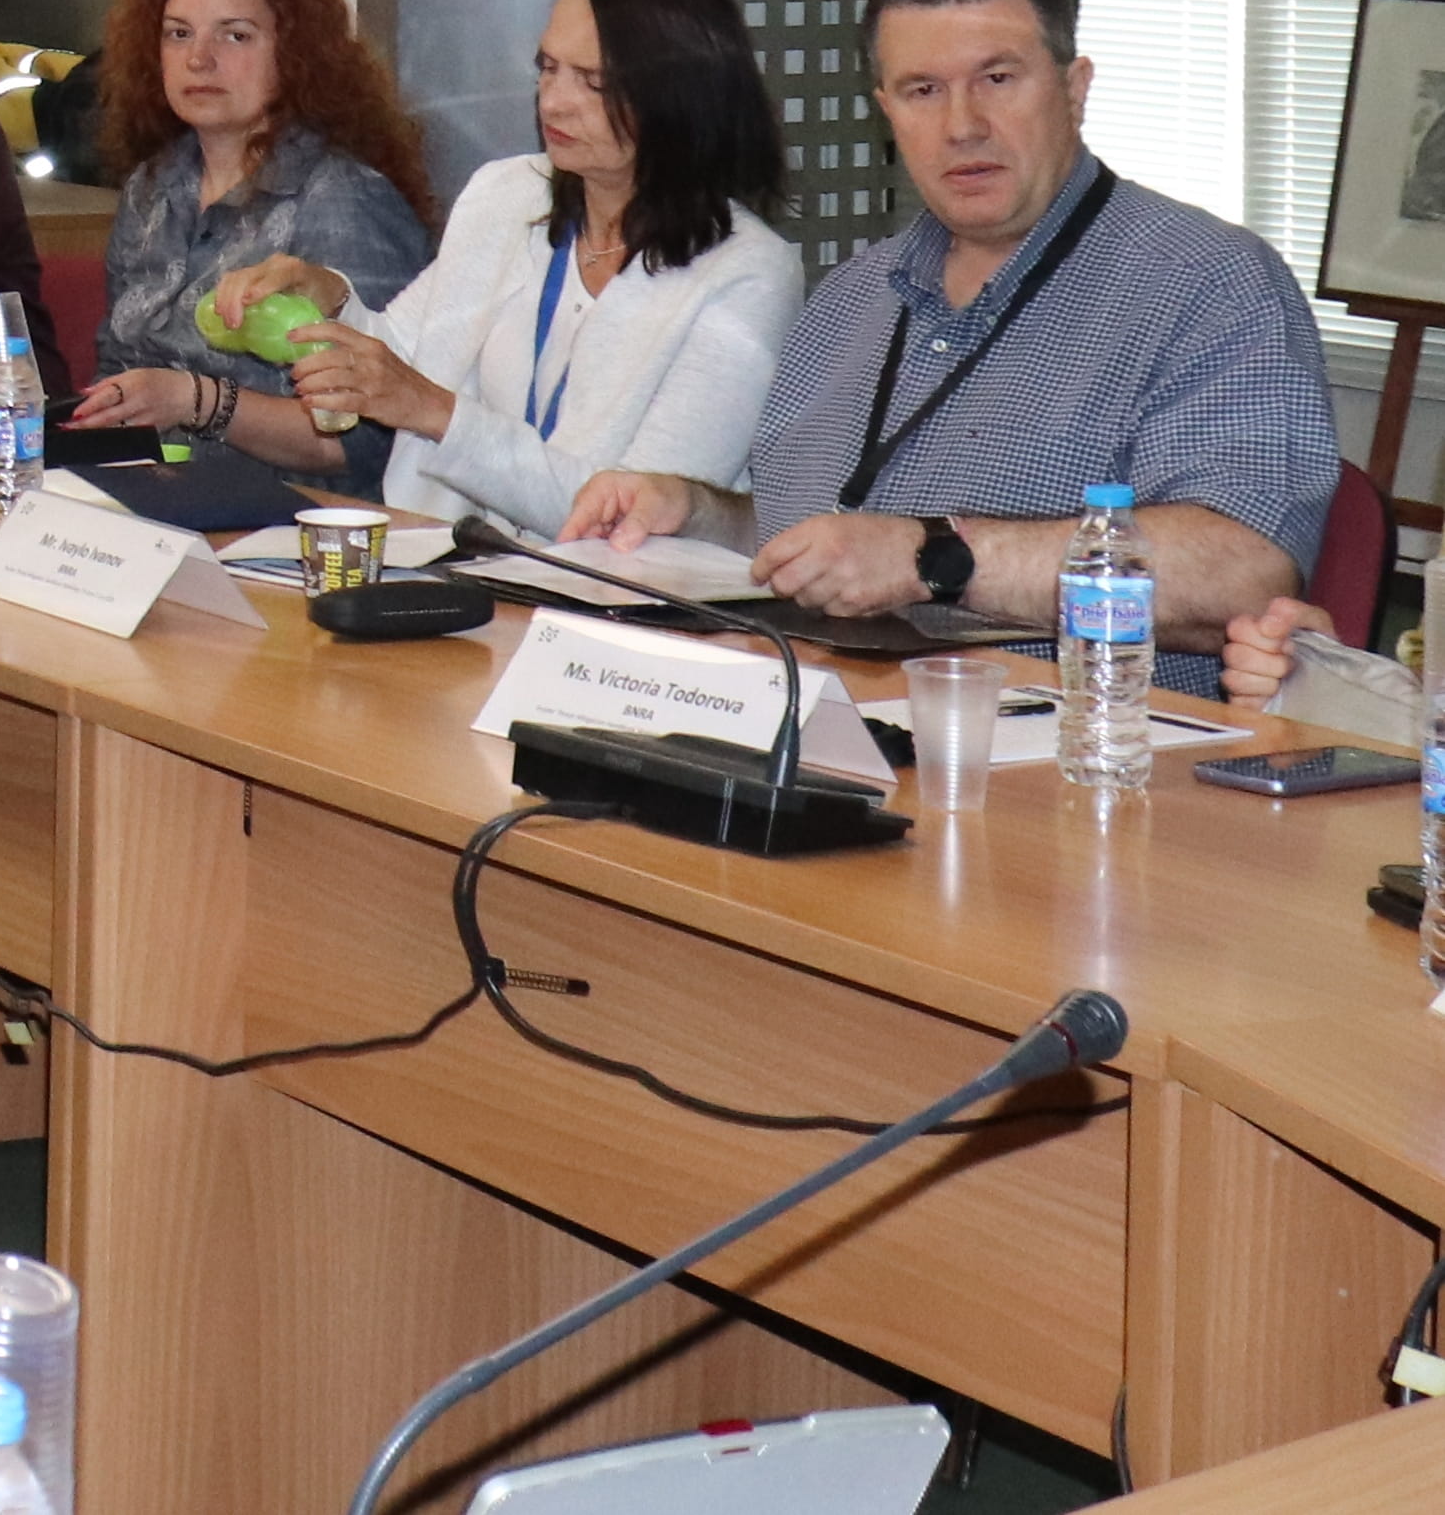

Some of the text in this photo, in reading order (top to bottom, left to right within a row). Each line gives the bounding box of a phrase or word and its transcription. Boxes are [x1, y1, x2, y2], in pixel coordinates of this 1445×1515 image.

[563, 661, 746, 715] Ms. Victoria Todorova
[622, 703, 656, 722] BNRA
